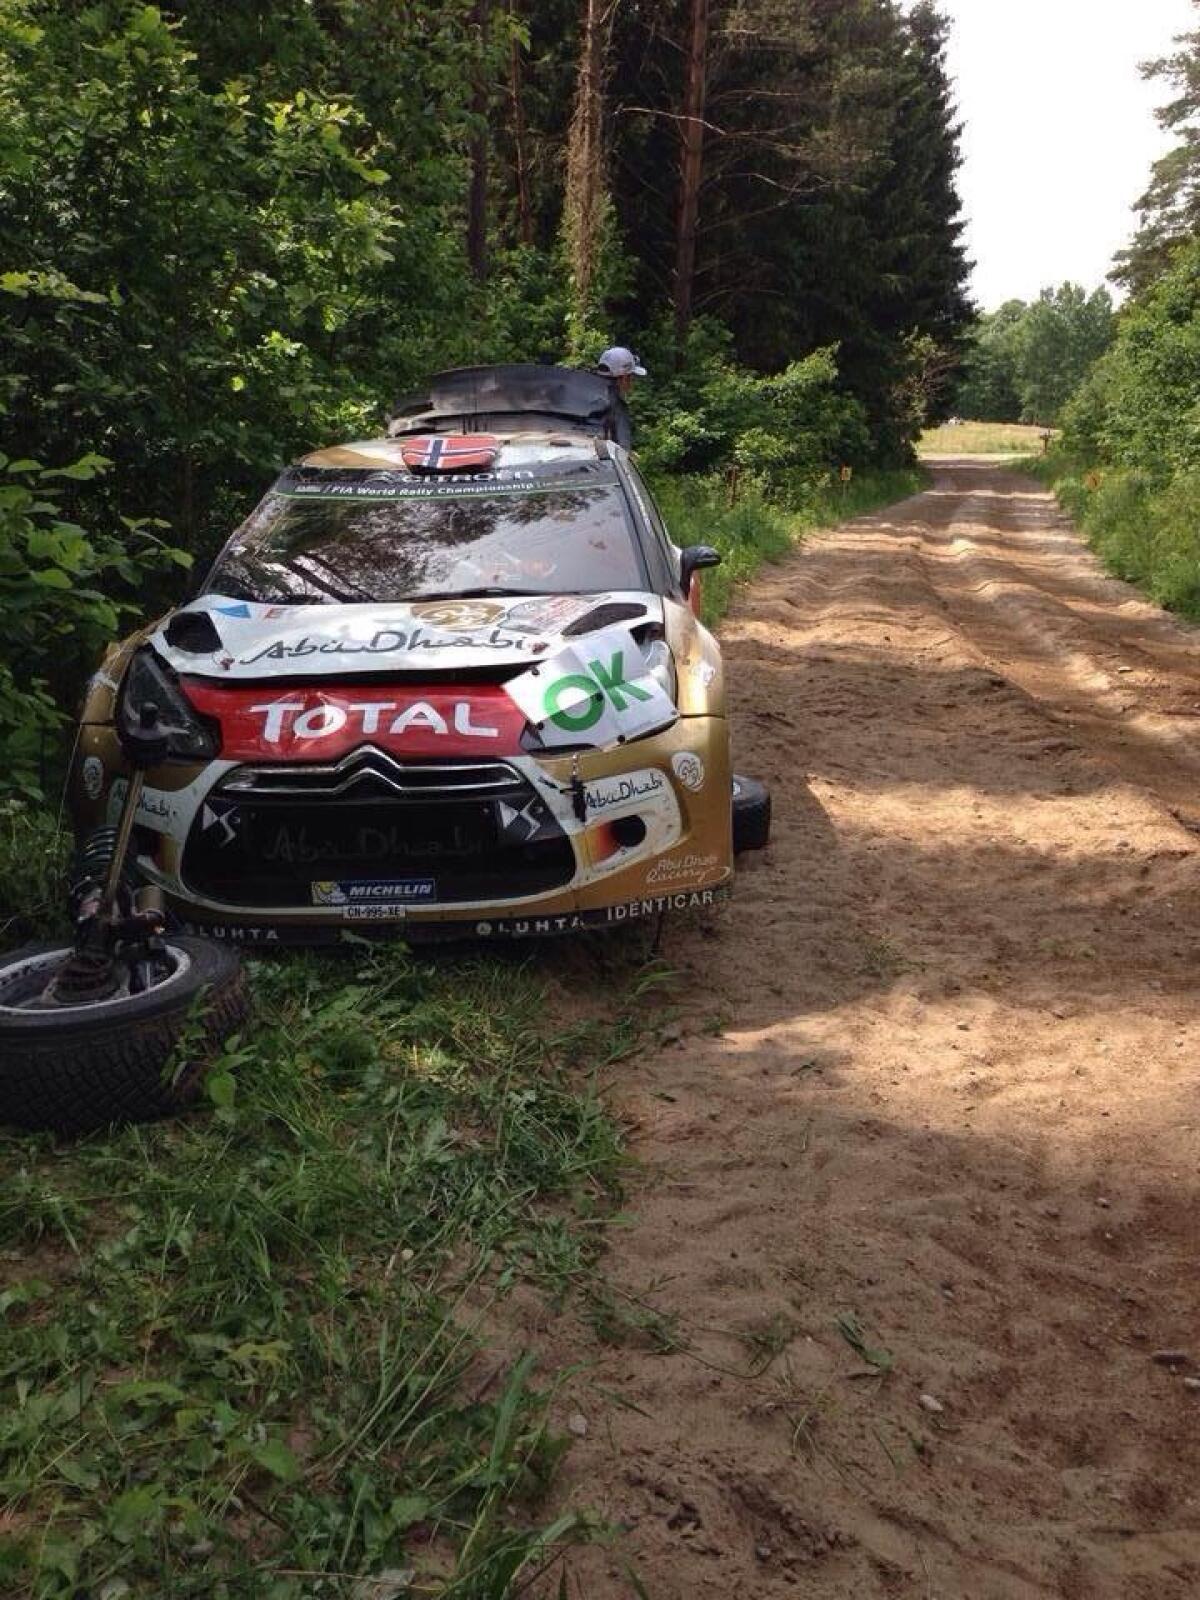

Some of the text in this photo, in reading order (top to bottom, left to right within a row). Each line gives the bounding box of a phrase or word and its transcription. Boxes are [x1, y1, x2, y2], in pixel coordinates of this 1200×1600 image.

[357, 487, 396, 496] World
[400, 488, 434, 497] Rally
[438, 482, 534, 495] Championship
[543, 650, 653, 732] OK
[249, 701, 500, 743] TOTAL
[349, 884, 432, 896] MICHELIN
[607, 890, 714, 922] IDENTICAR
[201, 926, 281, 941] LUHTA
[498, 915, 585, 935] LUHTA
